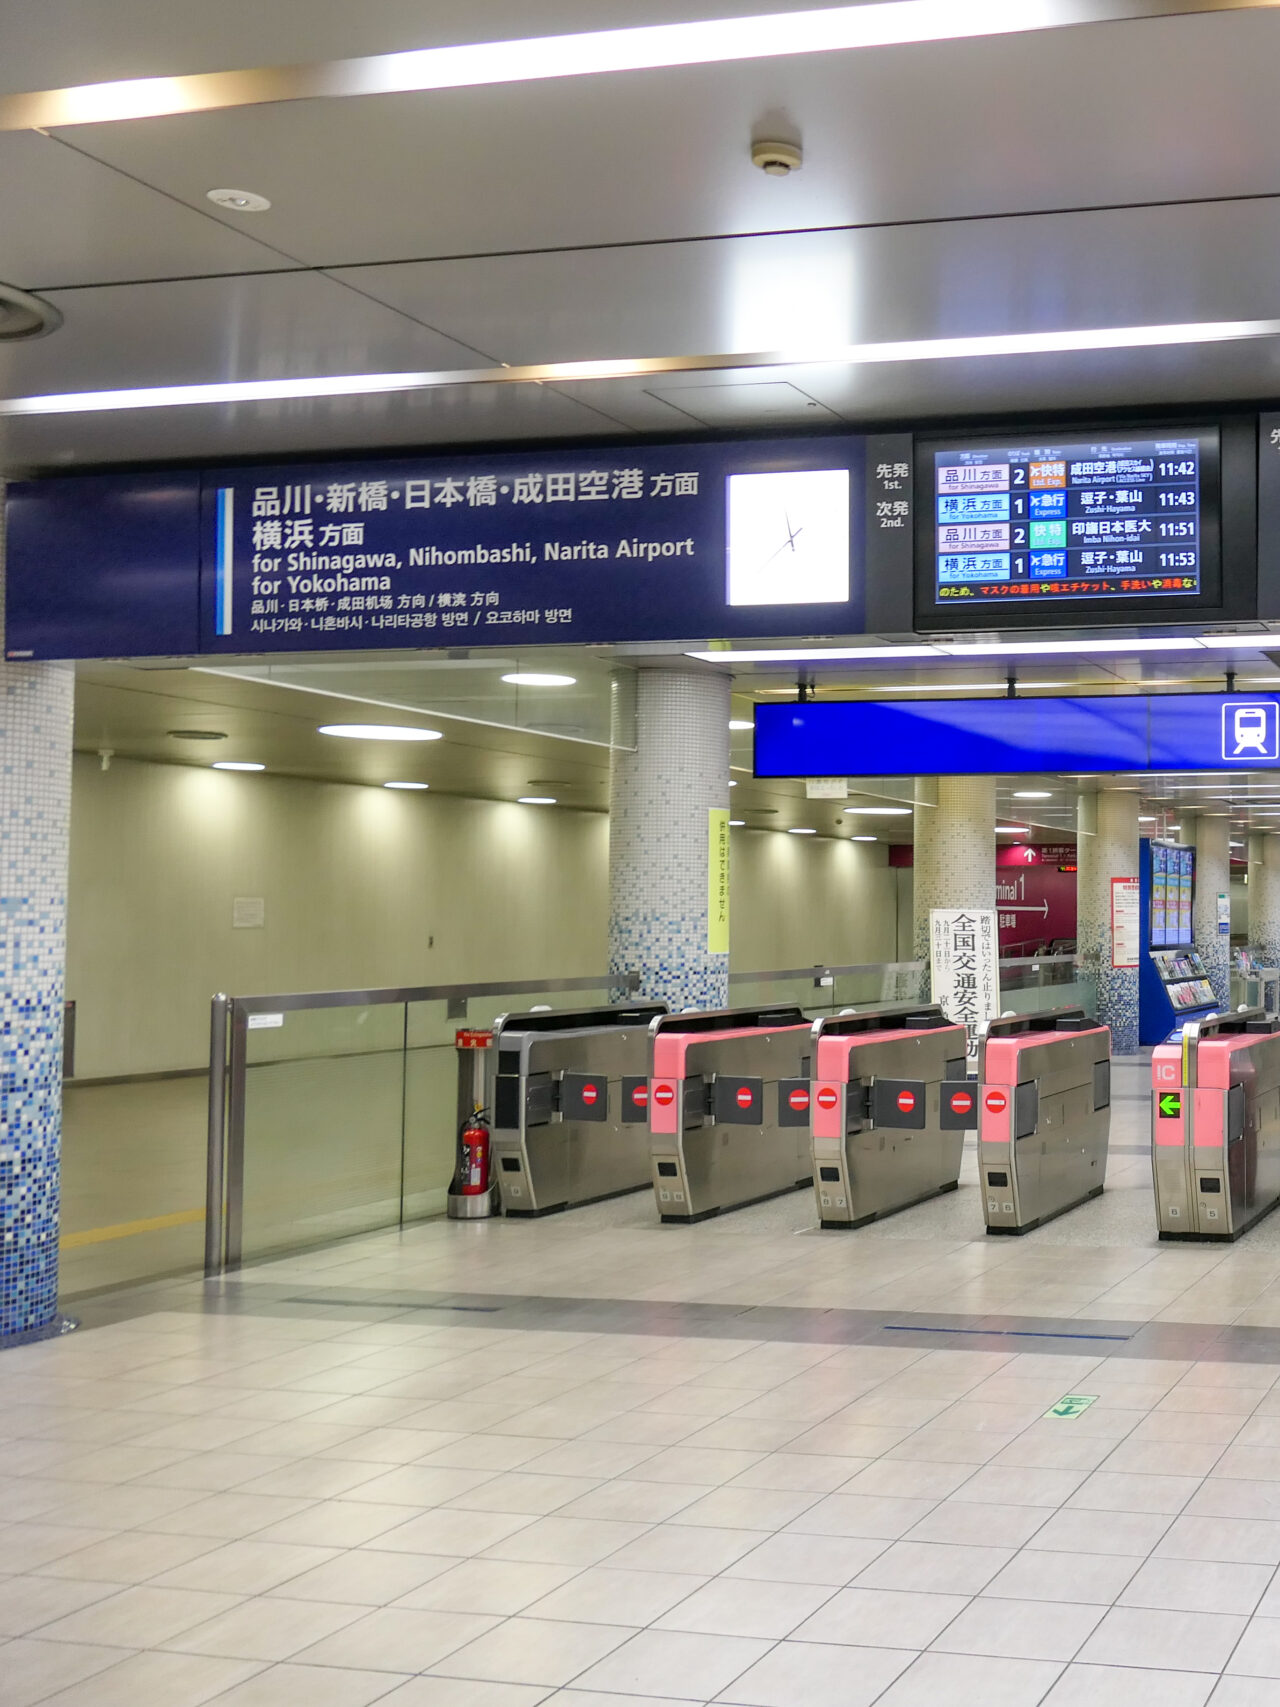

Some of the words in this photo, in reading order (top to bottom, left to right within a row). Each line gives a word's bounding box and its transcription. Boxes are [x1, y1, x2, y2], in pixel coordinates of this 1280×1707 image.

[876, 462, 910, 479] 先発
[1042, 462, 1066, 477] 快特
[1071, 460, 1117, 476] 成田空港
[1159, 461, 1195, 476] 11:42
[882, 479, 903, 490] 1st.
[1013, 468, 1025, 485] 2
[252, 468, 644, 517] 品川・新橋・日本橋・成田空港
[649, 472, 700, 498] 方面
[960, 481, 999, 492] Shinagawa
[1041, 493, 1065, 507] 急行
[1081, 489, 1143, 506] 逗子・葉山
[1159, 491, 1195, 507] 11:43
[876, 500, 910, 517] 次発
[1014, 498, 1024, 514] 1
[1034, 507, 1062, 517] Express
[960, 510, 998, 519] Yokohama
[880, 518, 905, 528] 2nd.
[1034, 523, 1063, 537] 快特
[1072, 519, 1152, 536] 印旛日本医大
[1159, 521, 1195, 537] 11:51
[252, 518, 314, 551] 横浜
[319, 522, 365, 547] 方面
[1014, 528, 1026, 544] 2
[960, 541, 999, 551] Shinagawa
[251, 553, 282, 573] for
[286, 551, 403, 574] Shinagawa,
[408, 542, 538, 567] Nihombashi,
[544, 540, 609, 561] Narita
[615, 537, 695, 562] Airport
[1041, 553, 1065, 567] 急行
[1081, 549, 1143, 566] 逗子・葉山
[1159, 552, 1196, 567] 11:53
[1014, 557, 1024, 574] 1
[1034, 567, 1062, 577] Express
[251, 575, 282, 595] for
[286, 572, 392, 595] Yokohama
[396, 594, 426, 609] 方向
[470, 591, 500, 607] 方向
[441, 611, 469, 626] 방면
[485, 609, 541, 625] 요코하마
[544, 608, 573, 624] 방면
[1019, 873, 1025, 901] 1
[1156, 1064, 1176, 1082] IC
